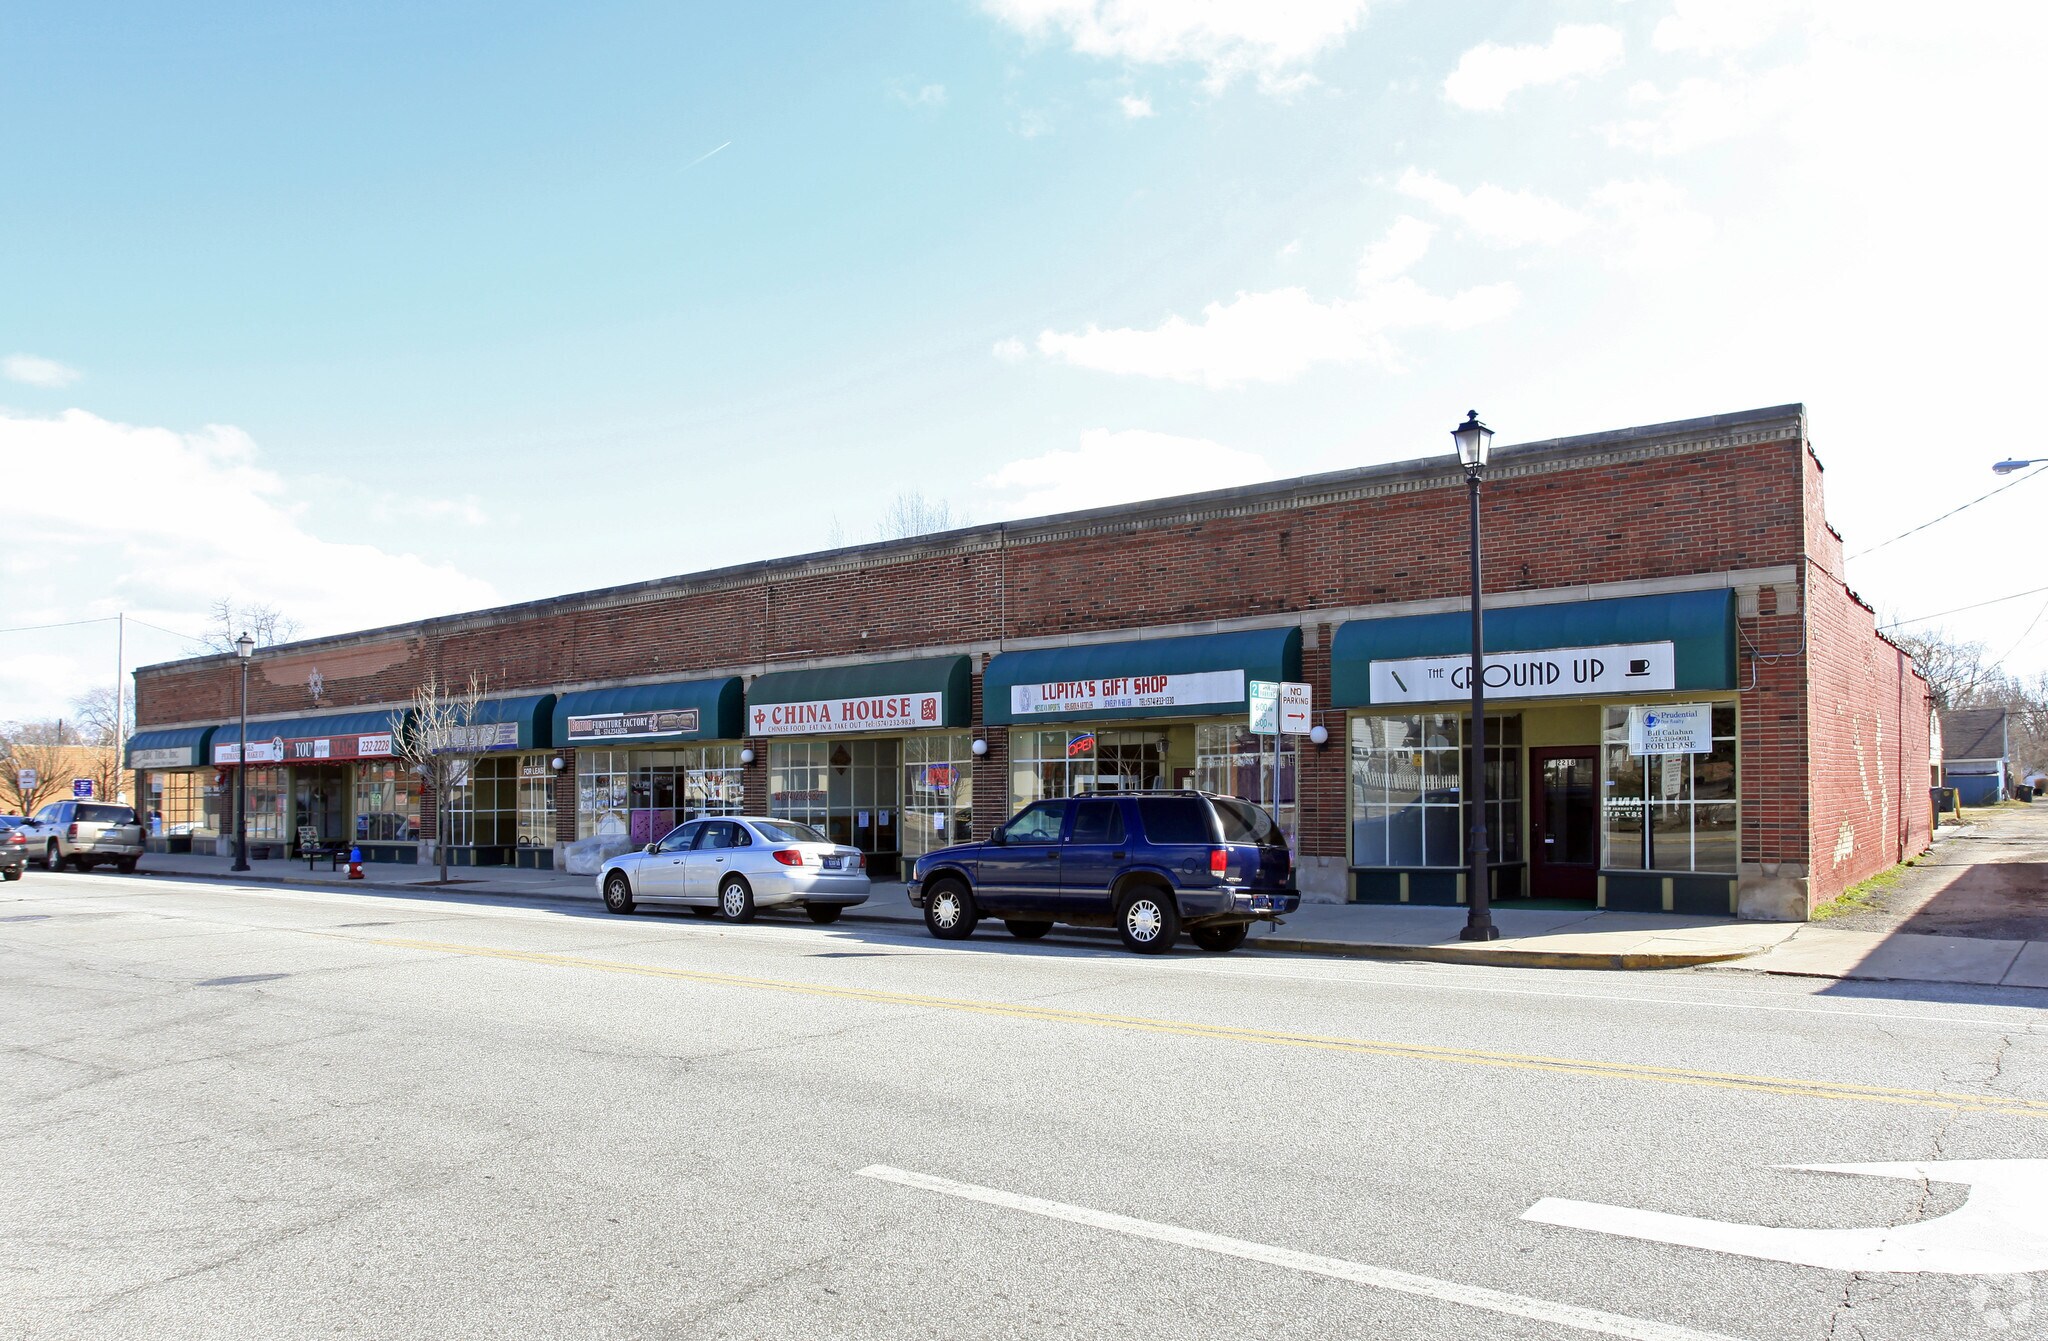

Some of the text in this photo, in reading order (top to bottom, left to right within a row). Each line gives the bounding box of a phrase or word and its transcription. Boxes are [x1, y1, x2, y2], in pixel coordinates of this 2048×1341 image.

[1428, 658, 1605, 690] THE GROUND UP
[1042, 675, 1169, 701] LUPITA'S GIFT SHOP
[1251, 684, 1258, 697] 2
[1290, 687, 1302, 696] NO
[1283, 697, 1309, 705] PARKING
[771, 698, 911, 725] CHINA HOUSE
[592, 719, 622, 728] FURNITURE
[622, 717, 648, 727] FACTORY
[753, 708, 767, 732] 中
[1068, 737, 1095, 756] OPEN
[1645, 741, 1696, 750] FOR LEASE
[533, 767, 545, 775] LEAS
